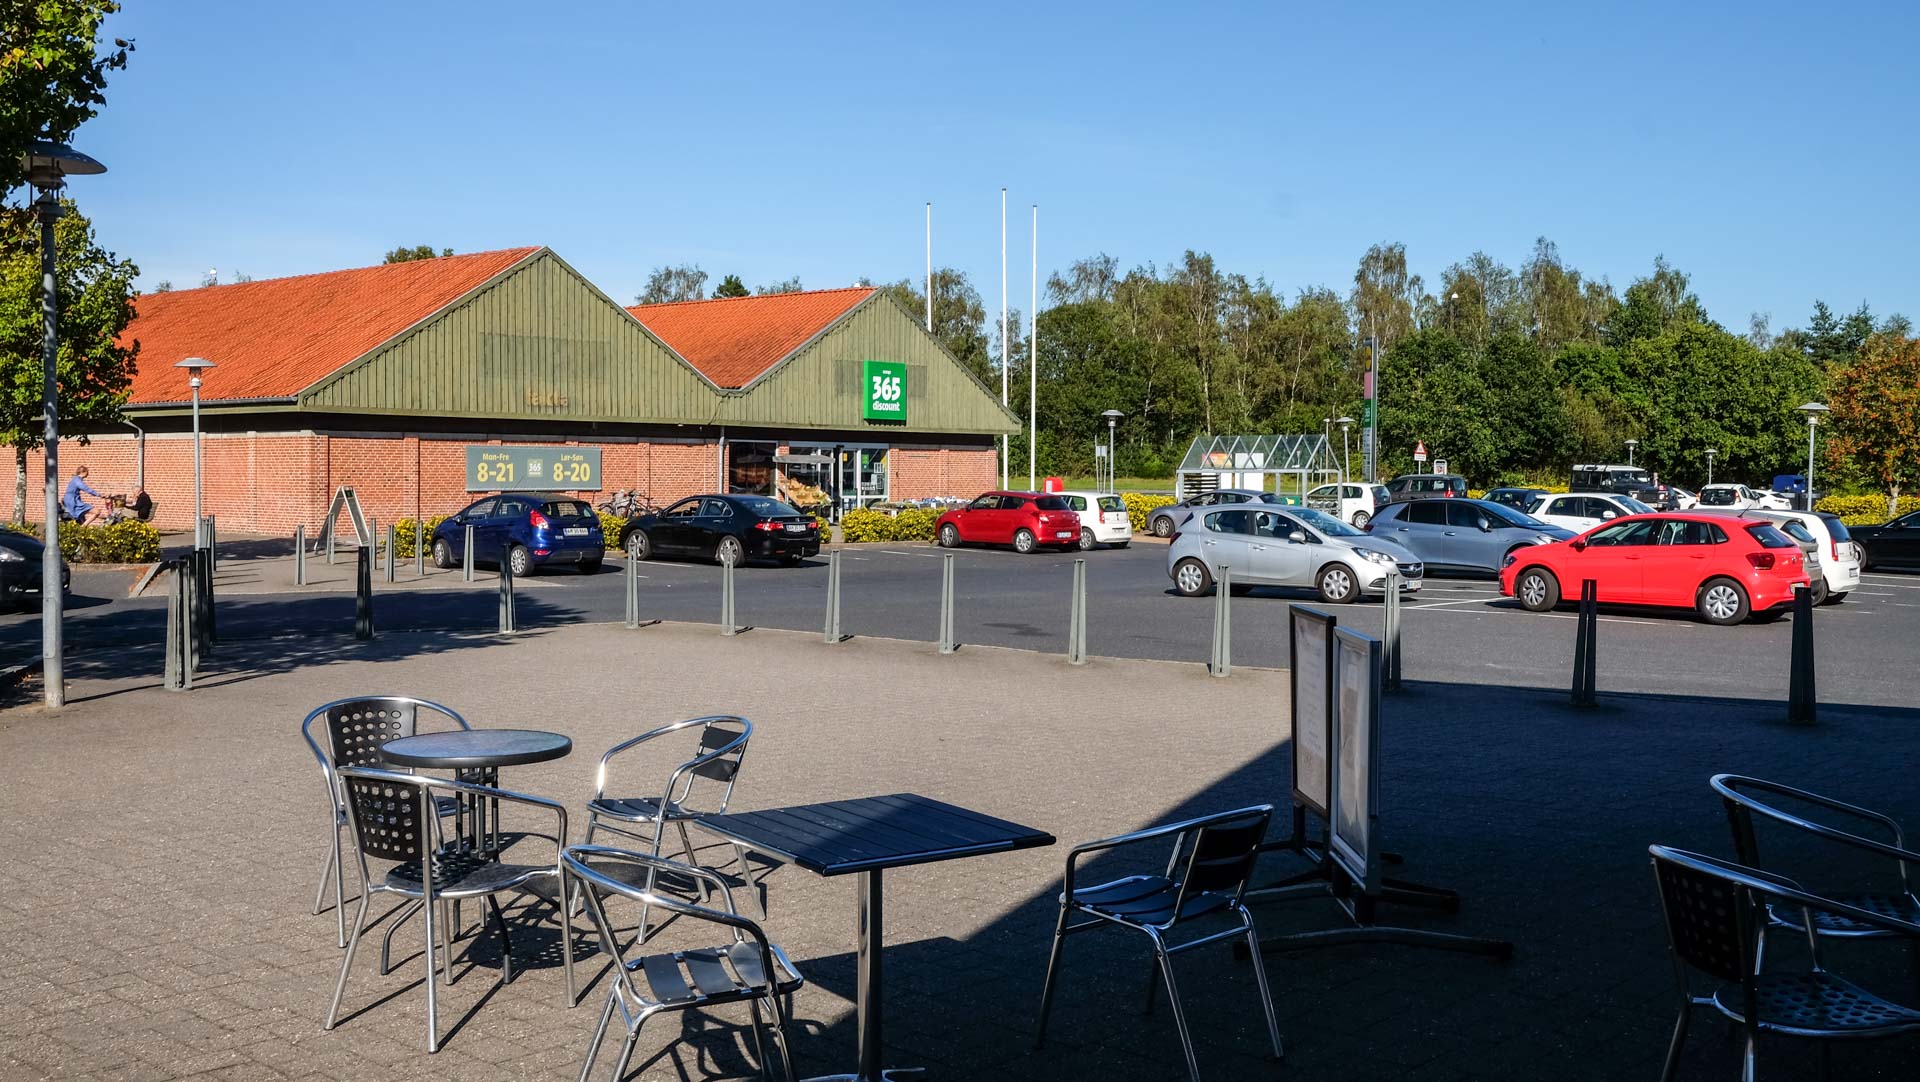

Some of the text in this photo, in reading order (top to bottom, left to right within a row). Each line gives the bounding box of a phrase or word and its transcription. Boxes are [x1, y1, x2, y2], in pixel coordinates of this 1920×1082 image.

[872, 376, 901, 400] 365
[872, 401, 900, 411] discount
[477, 462, 514, 482] 8-21
[528, 463, 542, 472] 365
[553, 462, 591, 482] 8-20
